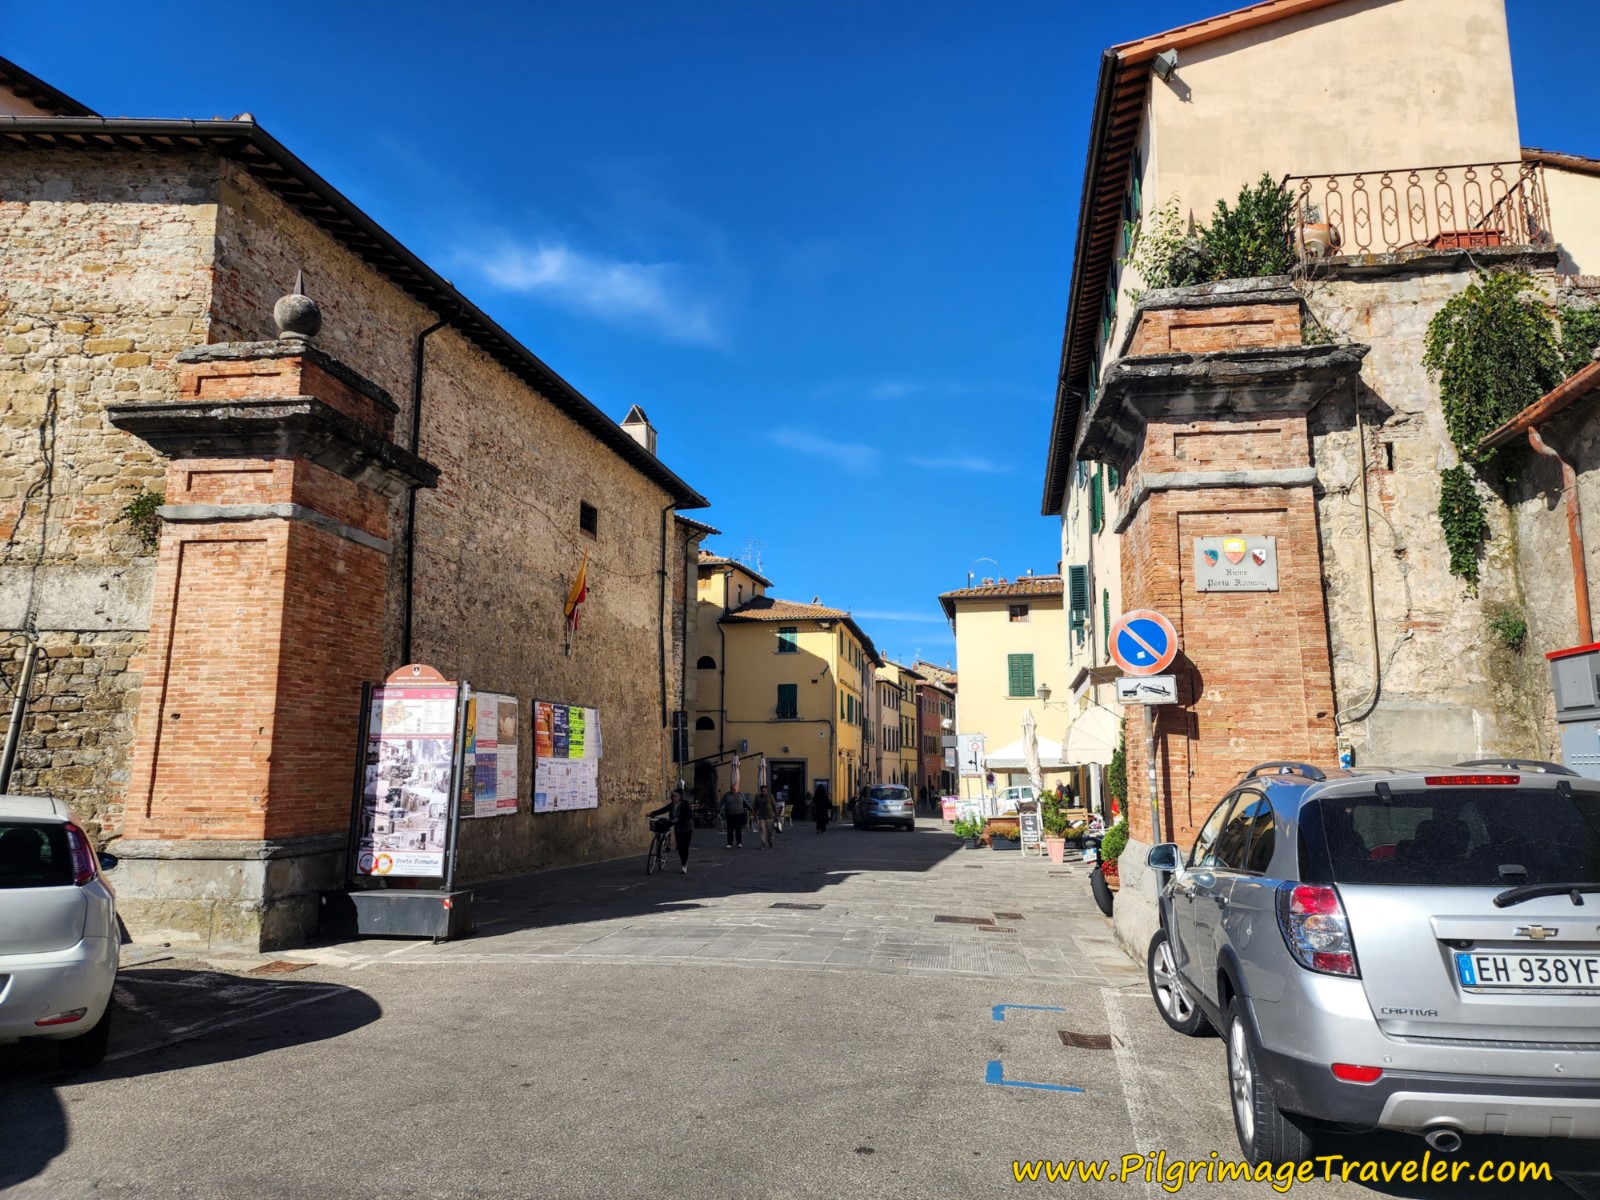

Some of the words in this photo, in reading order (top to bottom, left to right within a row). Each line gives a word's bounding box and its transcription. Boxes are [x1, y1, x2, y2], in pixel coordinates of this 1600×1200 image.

[1208, 579, 1229, 587] Porta
[1476, 957, 1510, 982] EH
[1518, 958, 1600, 984] 938YF
[1381, 1006, 1438, 1017] CAPTIVA
